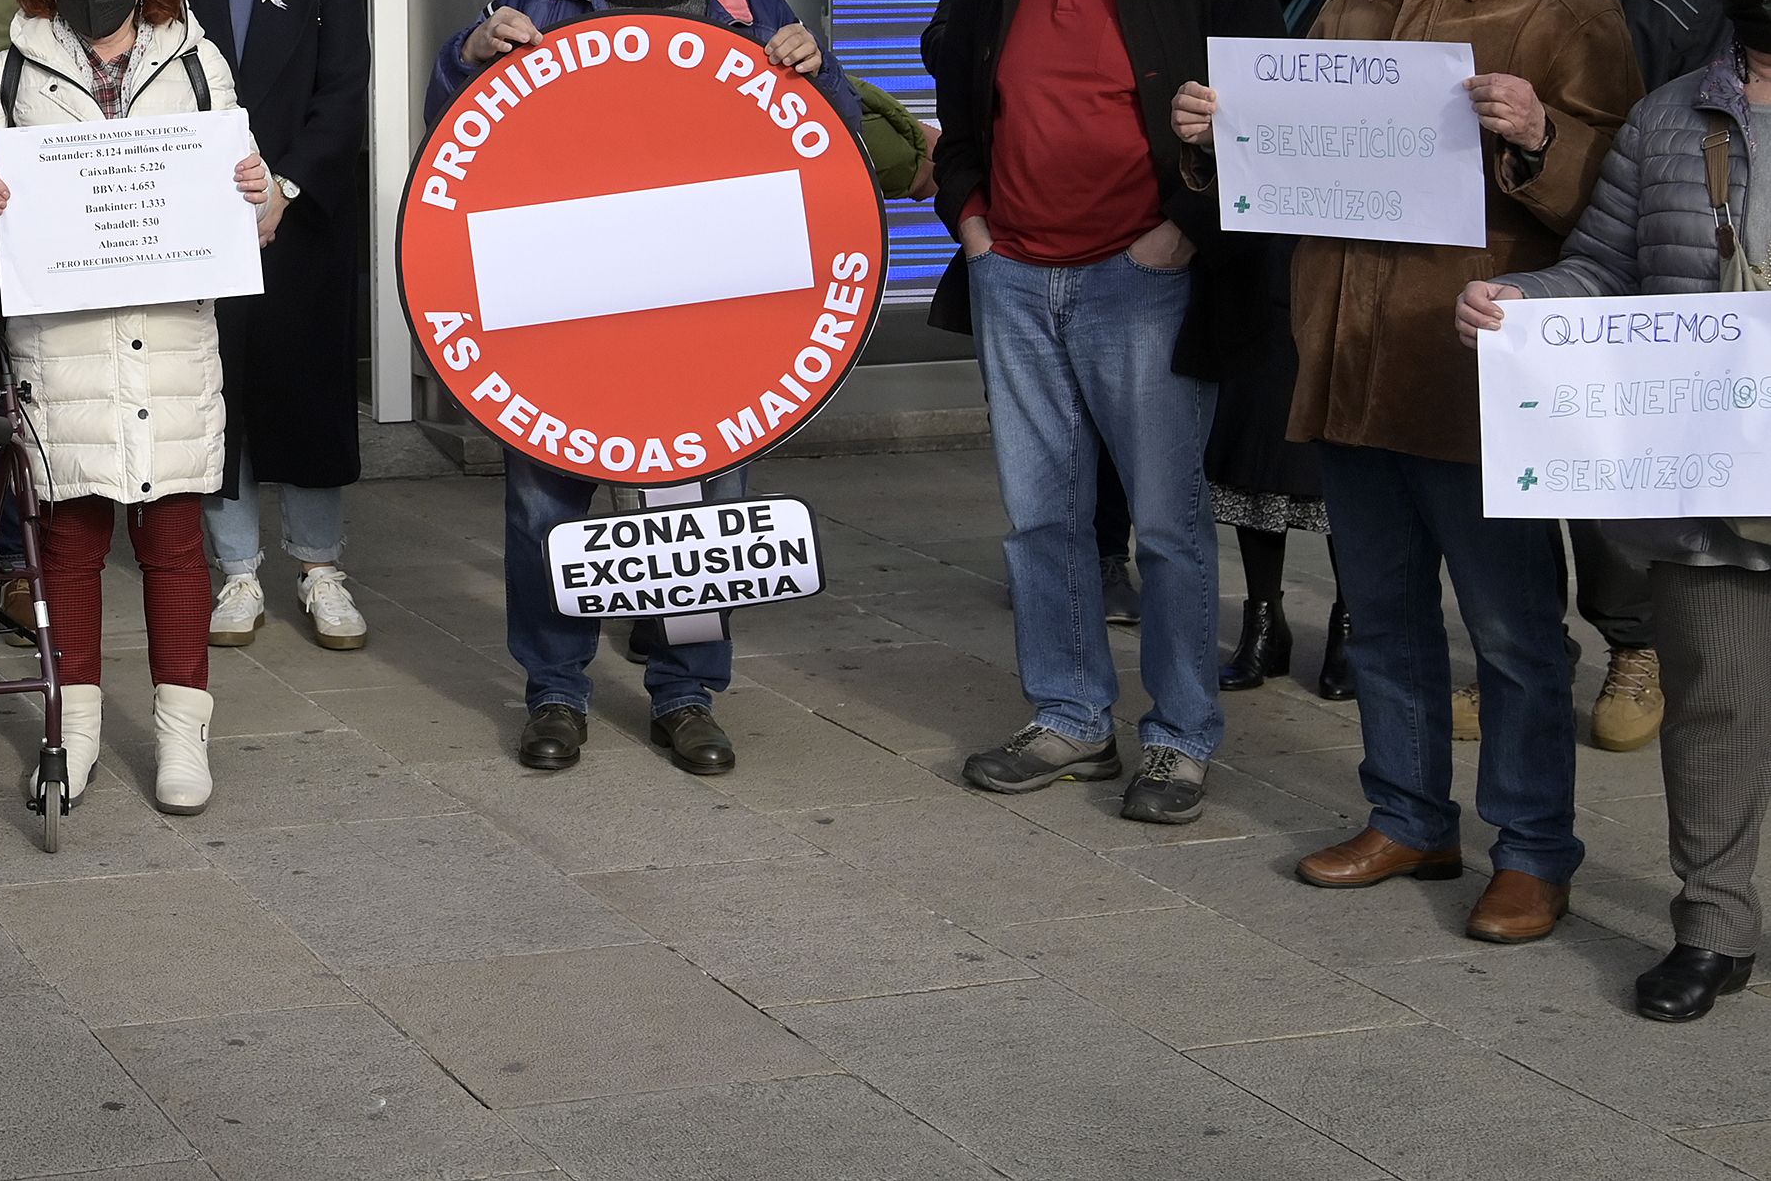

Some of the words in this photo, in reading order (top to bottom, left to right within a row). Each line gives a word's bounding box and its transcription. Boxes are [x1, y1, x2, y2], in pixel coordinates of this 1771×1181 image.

[1254, 53, 1401, 85] QUEREMOS
[421, 26, 650, 211] PROHIBIDO
[667, 32, 705, 69] O
[714, 47, 830, 159] PASO
[55, 133, 98, 145] MAIORES
[99, 129, 133, 141] DAMOS
[38, 148, 93, 163] Santander:
[96, 147, 122, 158] 8.124
[124, 144, 160, 155] millóns
[161, 142, 174, 152] de
[176, 141, 203, 152] euros
[79, 164, 138, 178] CaixaBank:
[139, 161, 166, 173] 5.226
[92, 182, 128, 195] BBVA:
[129, 180, 156, 192] 4.653
[85, 201, 138, 214] Bankinter:
[141, 198, 166, 210] 1.333
[94, 218, 140, 232] Sabadell:
[142, 216, 160, 228] 530
[98, 237, 140, 250] Abanca:
[141, 235, 159, 246] 323
[82, 253, 134, 267] RECIBIMOS
[135, 251, 164, 263] MALA
[166, 246, 212, 261] ATENCIÓN
[1541, 311, 1742, 346] QUEREMOS
[423, 311, 482, 372] ÁS
[470, 370, 708, 474] PERSOAS
[716, 251, 870, 454] MAIORES
[1545, 447, 1734, 492] SERVIZOS
[583, 513, 705, 552] ZONA
[717, 505, 774, 538] DE
[561, 535, 808, 590] EXCLUSIÓN
[577, 575, 802, 614] BANCARIA
